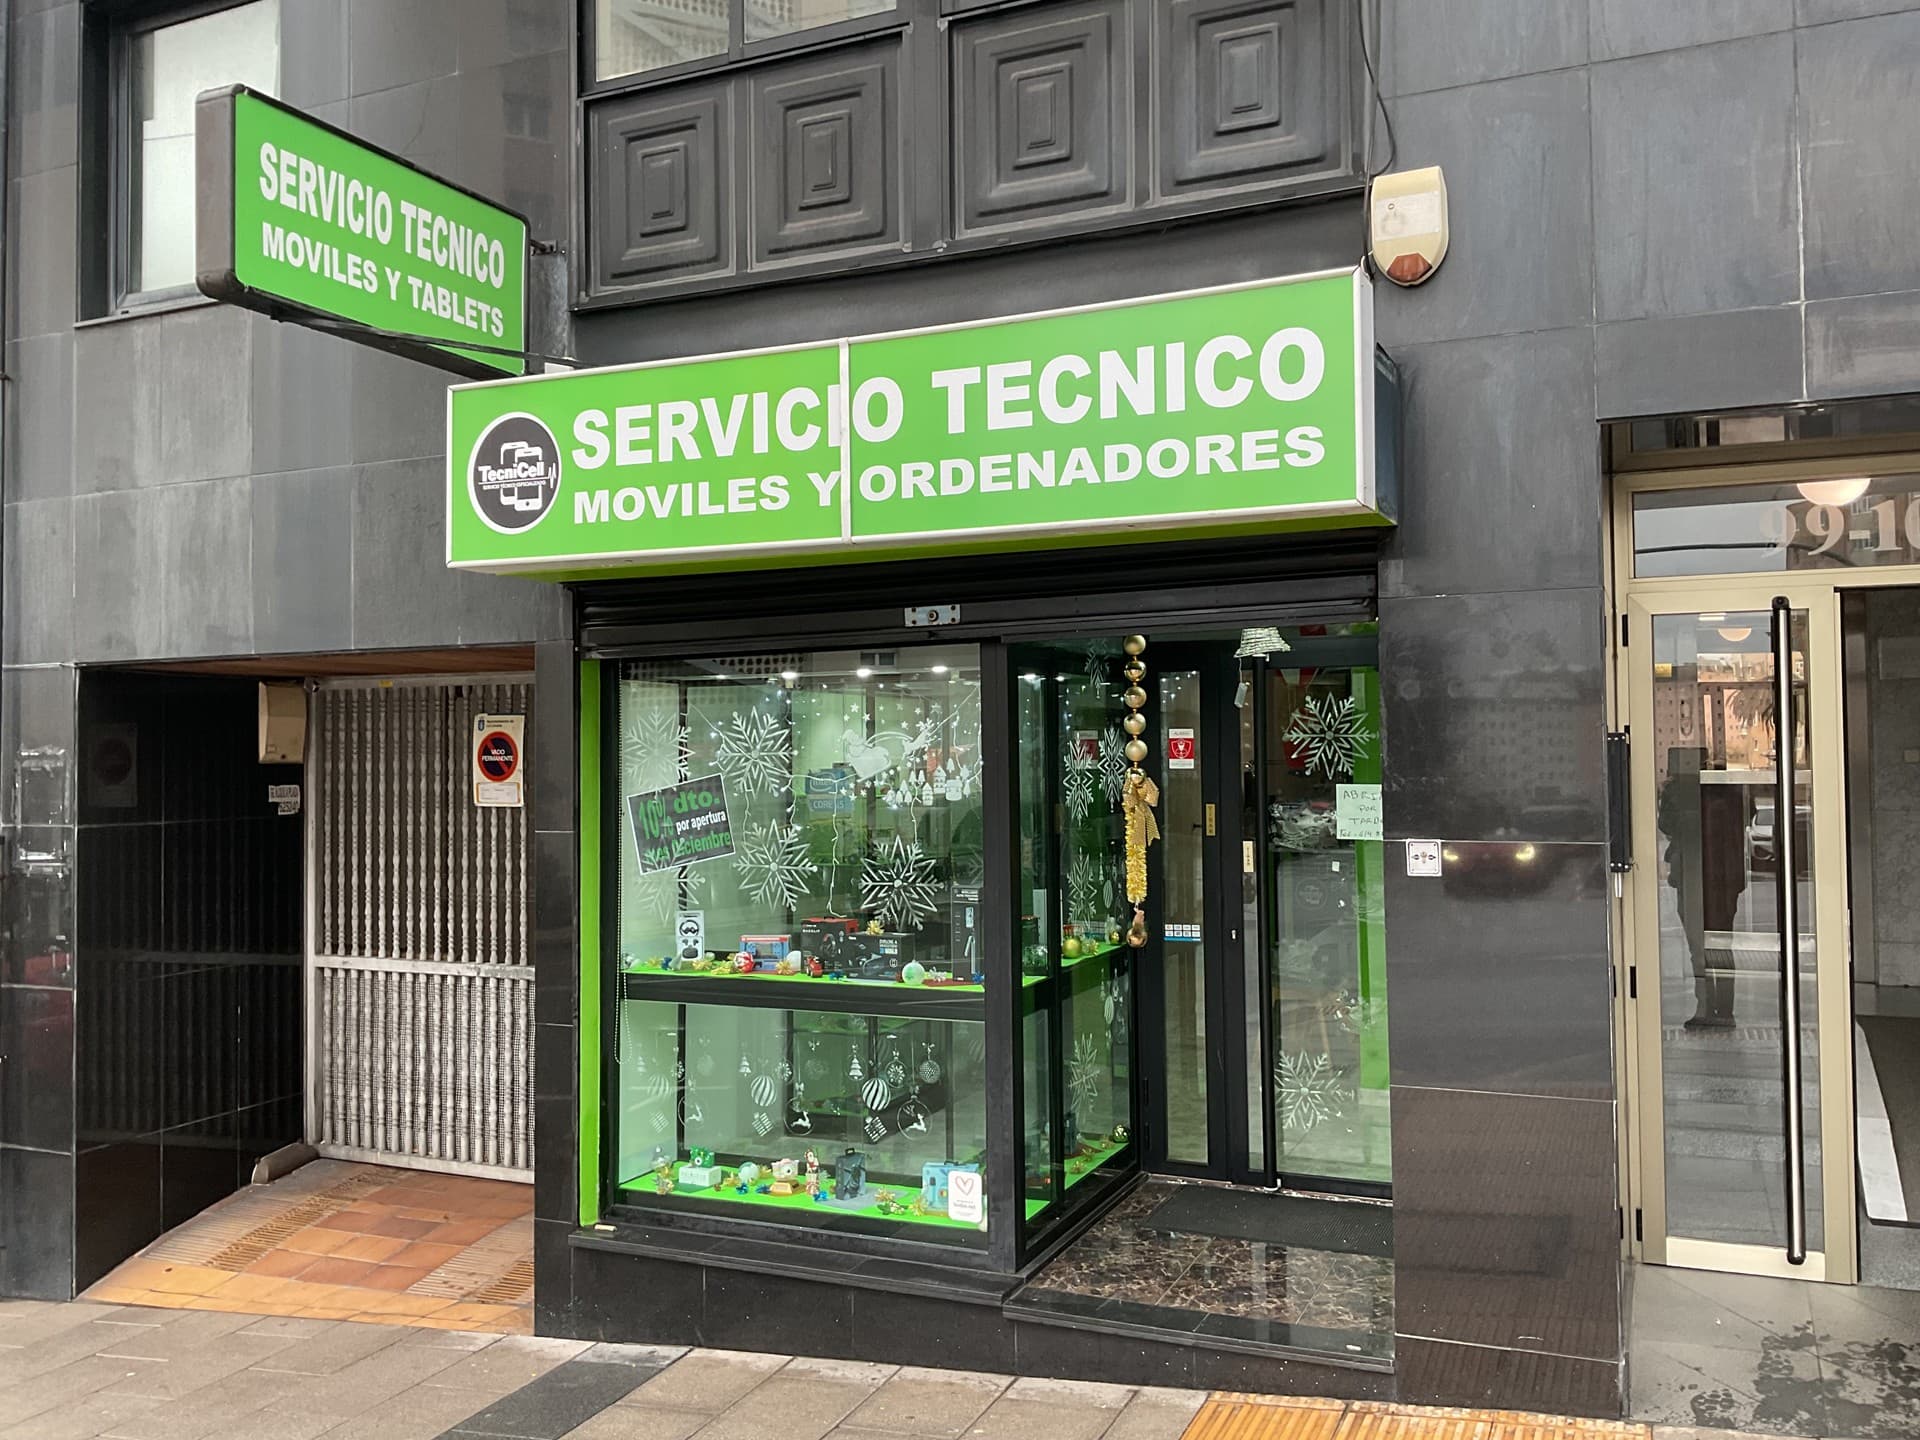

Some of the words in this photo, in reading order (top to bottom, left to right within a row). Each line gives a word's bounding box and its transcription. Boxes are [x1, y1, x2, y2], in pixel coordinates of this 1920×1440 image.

[259, 142, 393, 245] SERVICIO
[400, 200, 504, 288] TECNICO
[262, 222, 378, 294] MOVILES
[384, 267, 401, 300] Y
[407, 275, 504, 338] TABLETS
[571, 376, 904, 470] SERVICIO
[931, 327, 1325, 434] TECNICO
[478, 461, 545, 482] TecniCell
[573, 475, 790, 525] MOVILES
[807, 470, 841, 507] Y
[859, 425, 1325, 502] ORDENADORES
[639, 797, 674, 840] 10%
[673, 790, 720, 814] dto.
[675, 818, 690, 835] por
[691, 810, 726, 831] apertura
[1348, 816, 1383, 826] TARD
